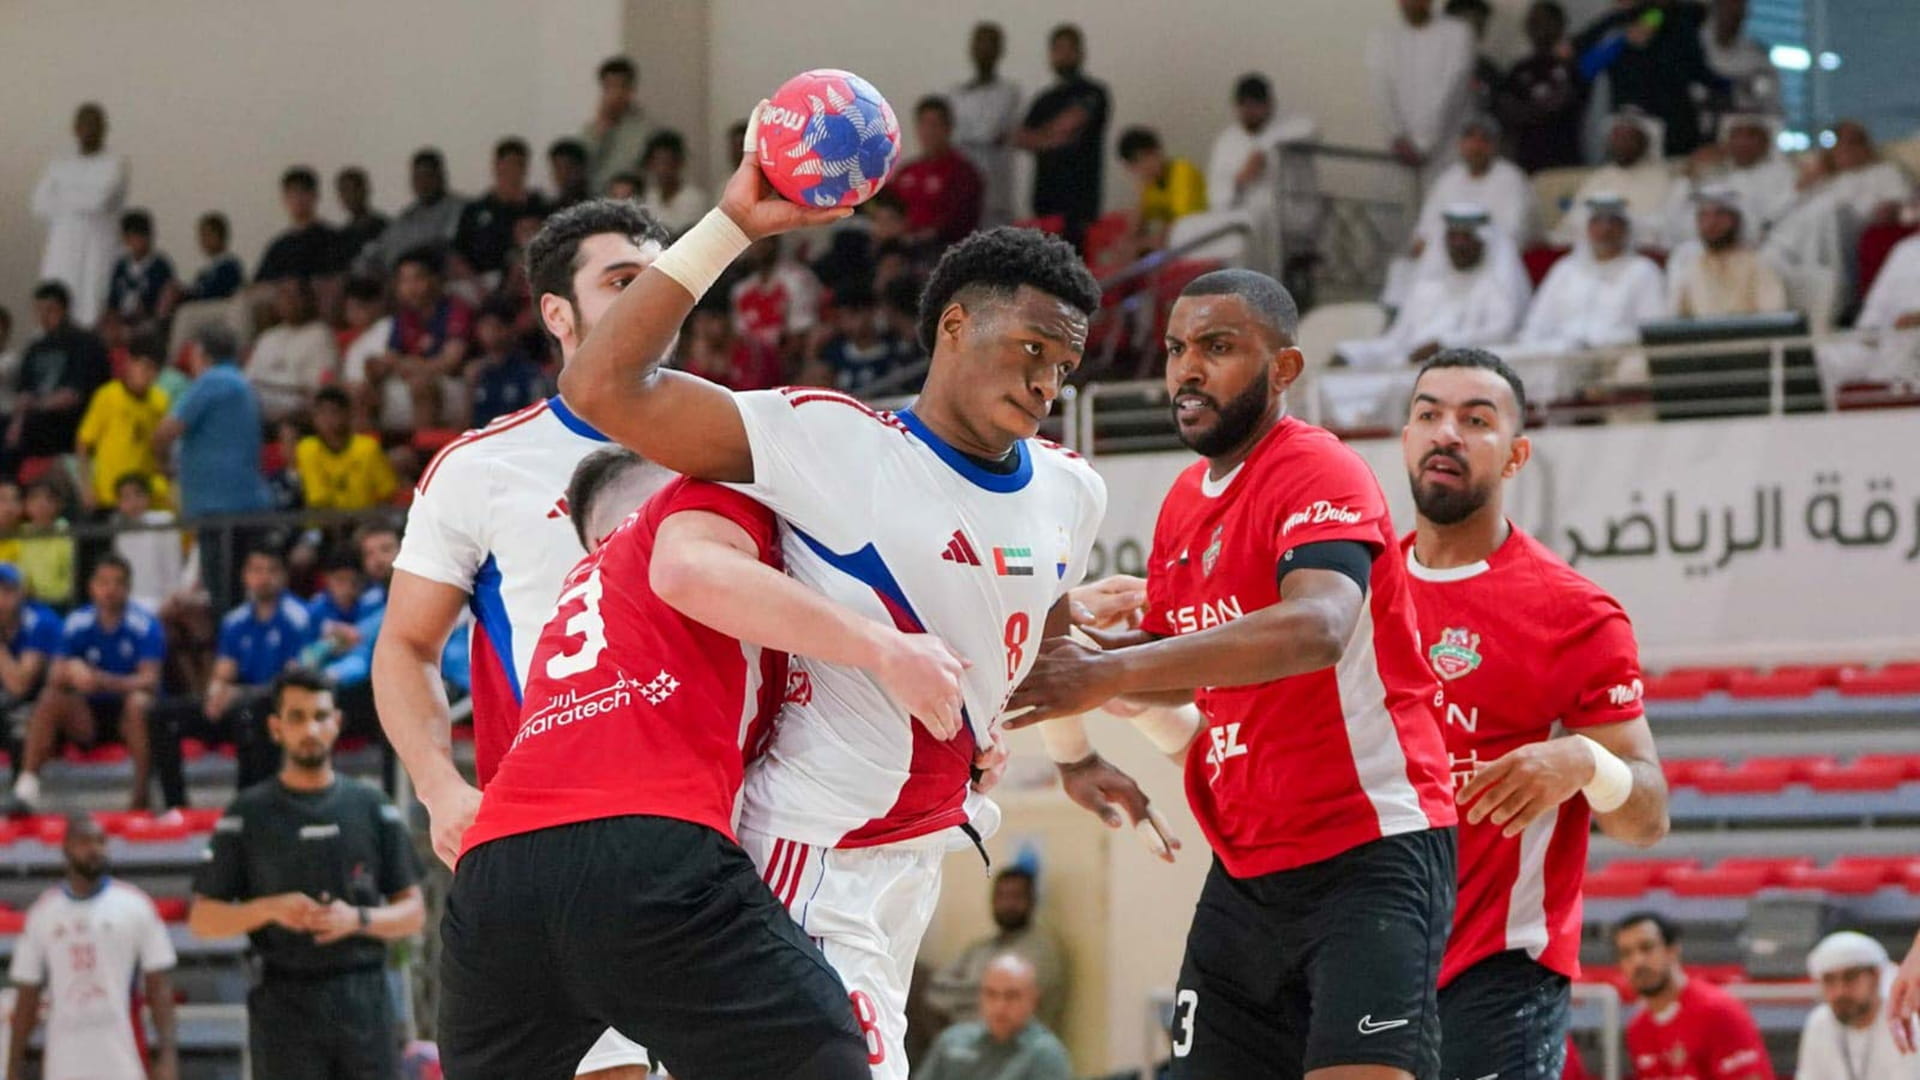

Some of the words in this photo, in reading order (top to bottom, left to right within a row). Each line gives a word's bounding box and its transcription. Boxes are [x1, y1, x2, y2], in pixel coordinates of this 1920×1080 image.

[1004, 611, 1029, 681] 8
[849, 990, 886, 1066] 8
[1173, 989, 1199, 1057] 3
